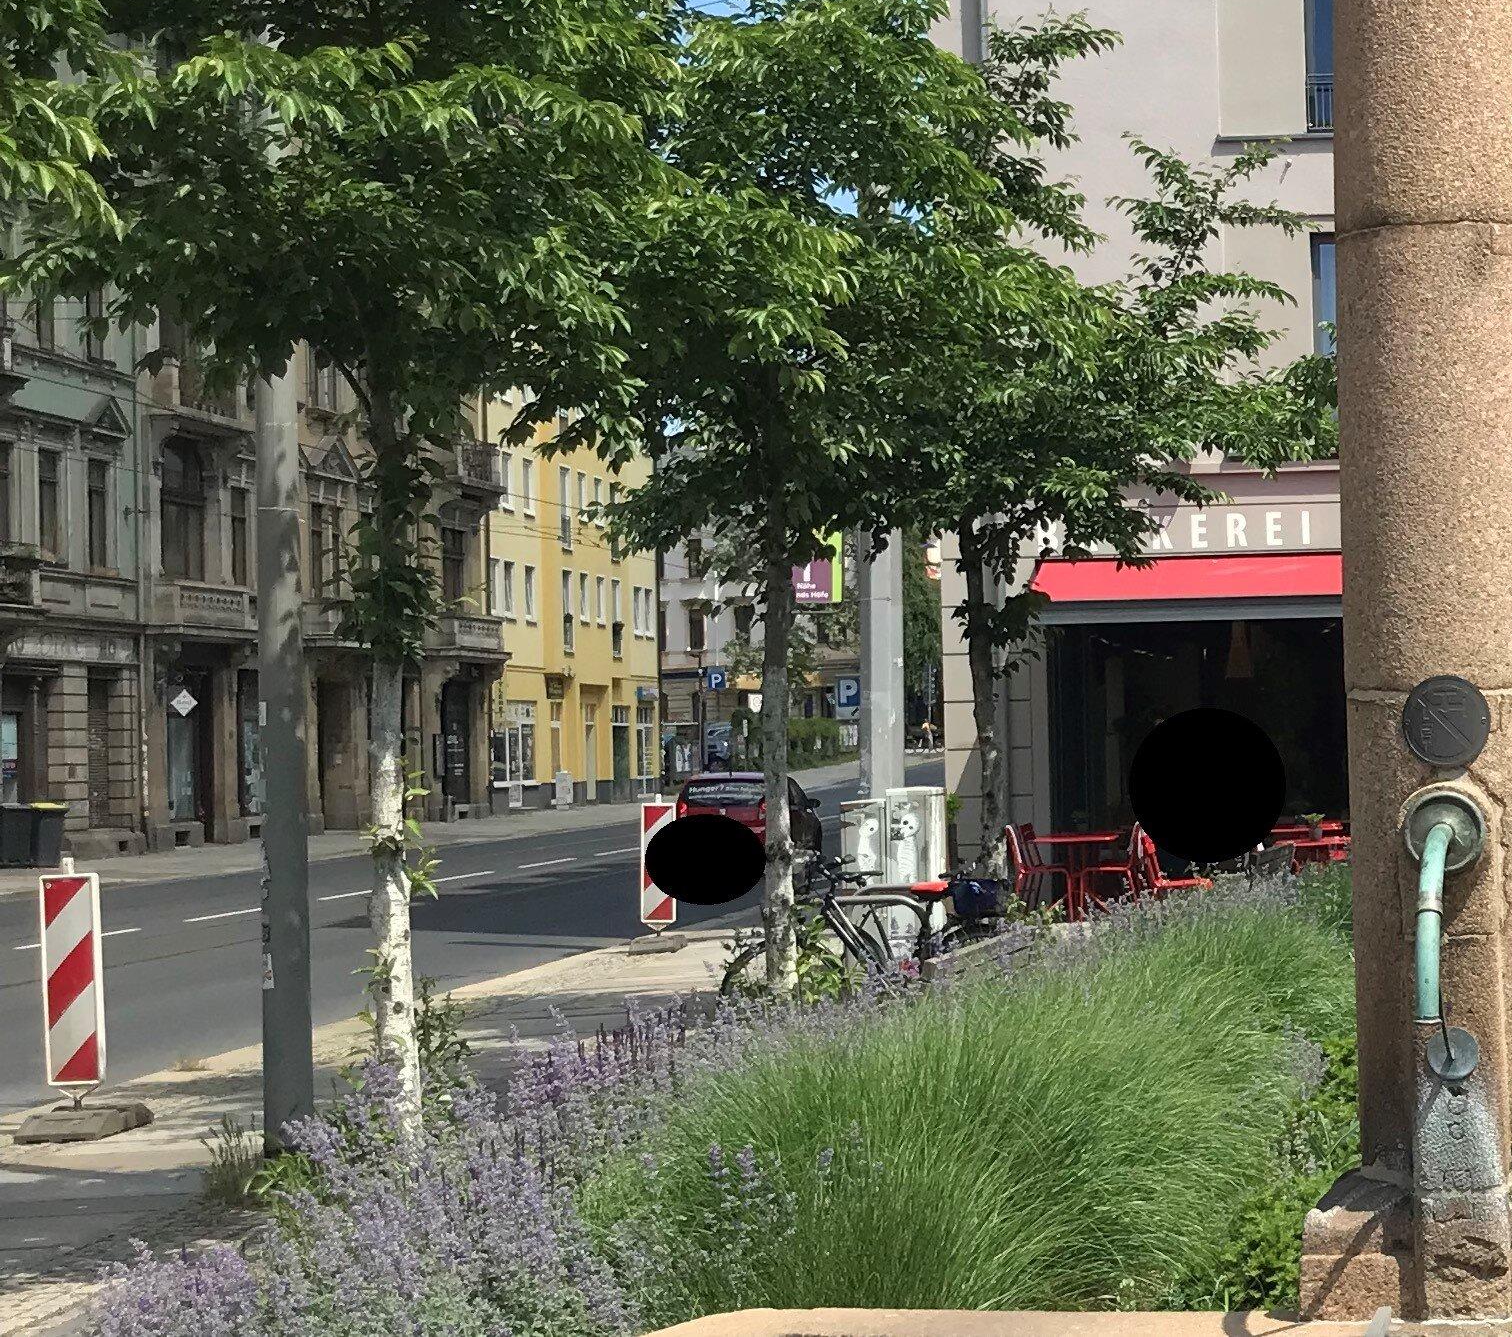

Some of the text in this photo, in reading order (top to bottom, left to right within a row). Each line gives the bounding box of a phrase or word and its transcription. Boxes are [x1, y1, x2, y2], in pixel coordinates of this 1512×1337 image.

[1036, 510, 1311, 552] BKEREI
[711, 673, 722, 688] P
[840, 679, 858, 703] P
